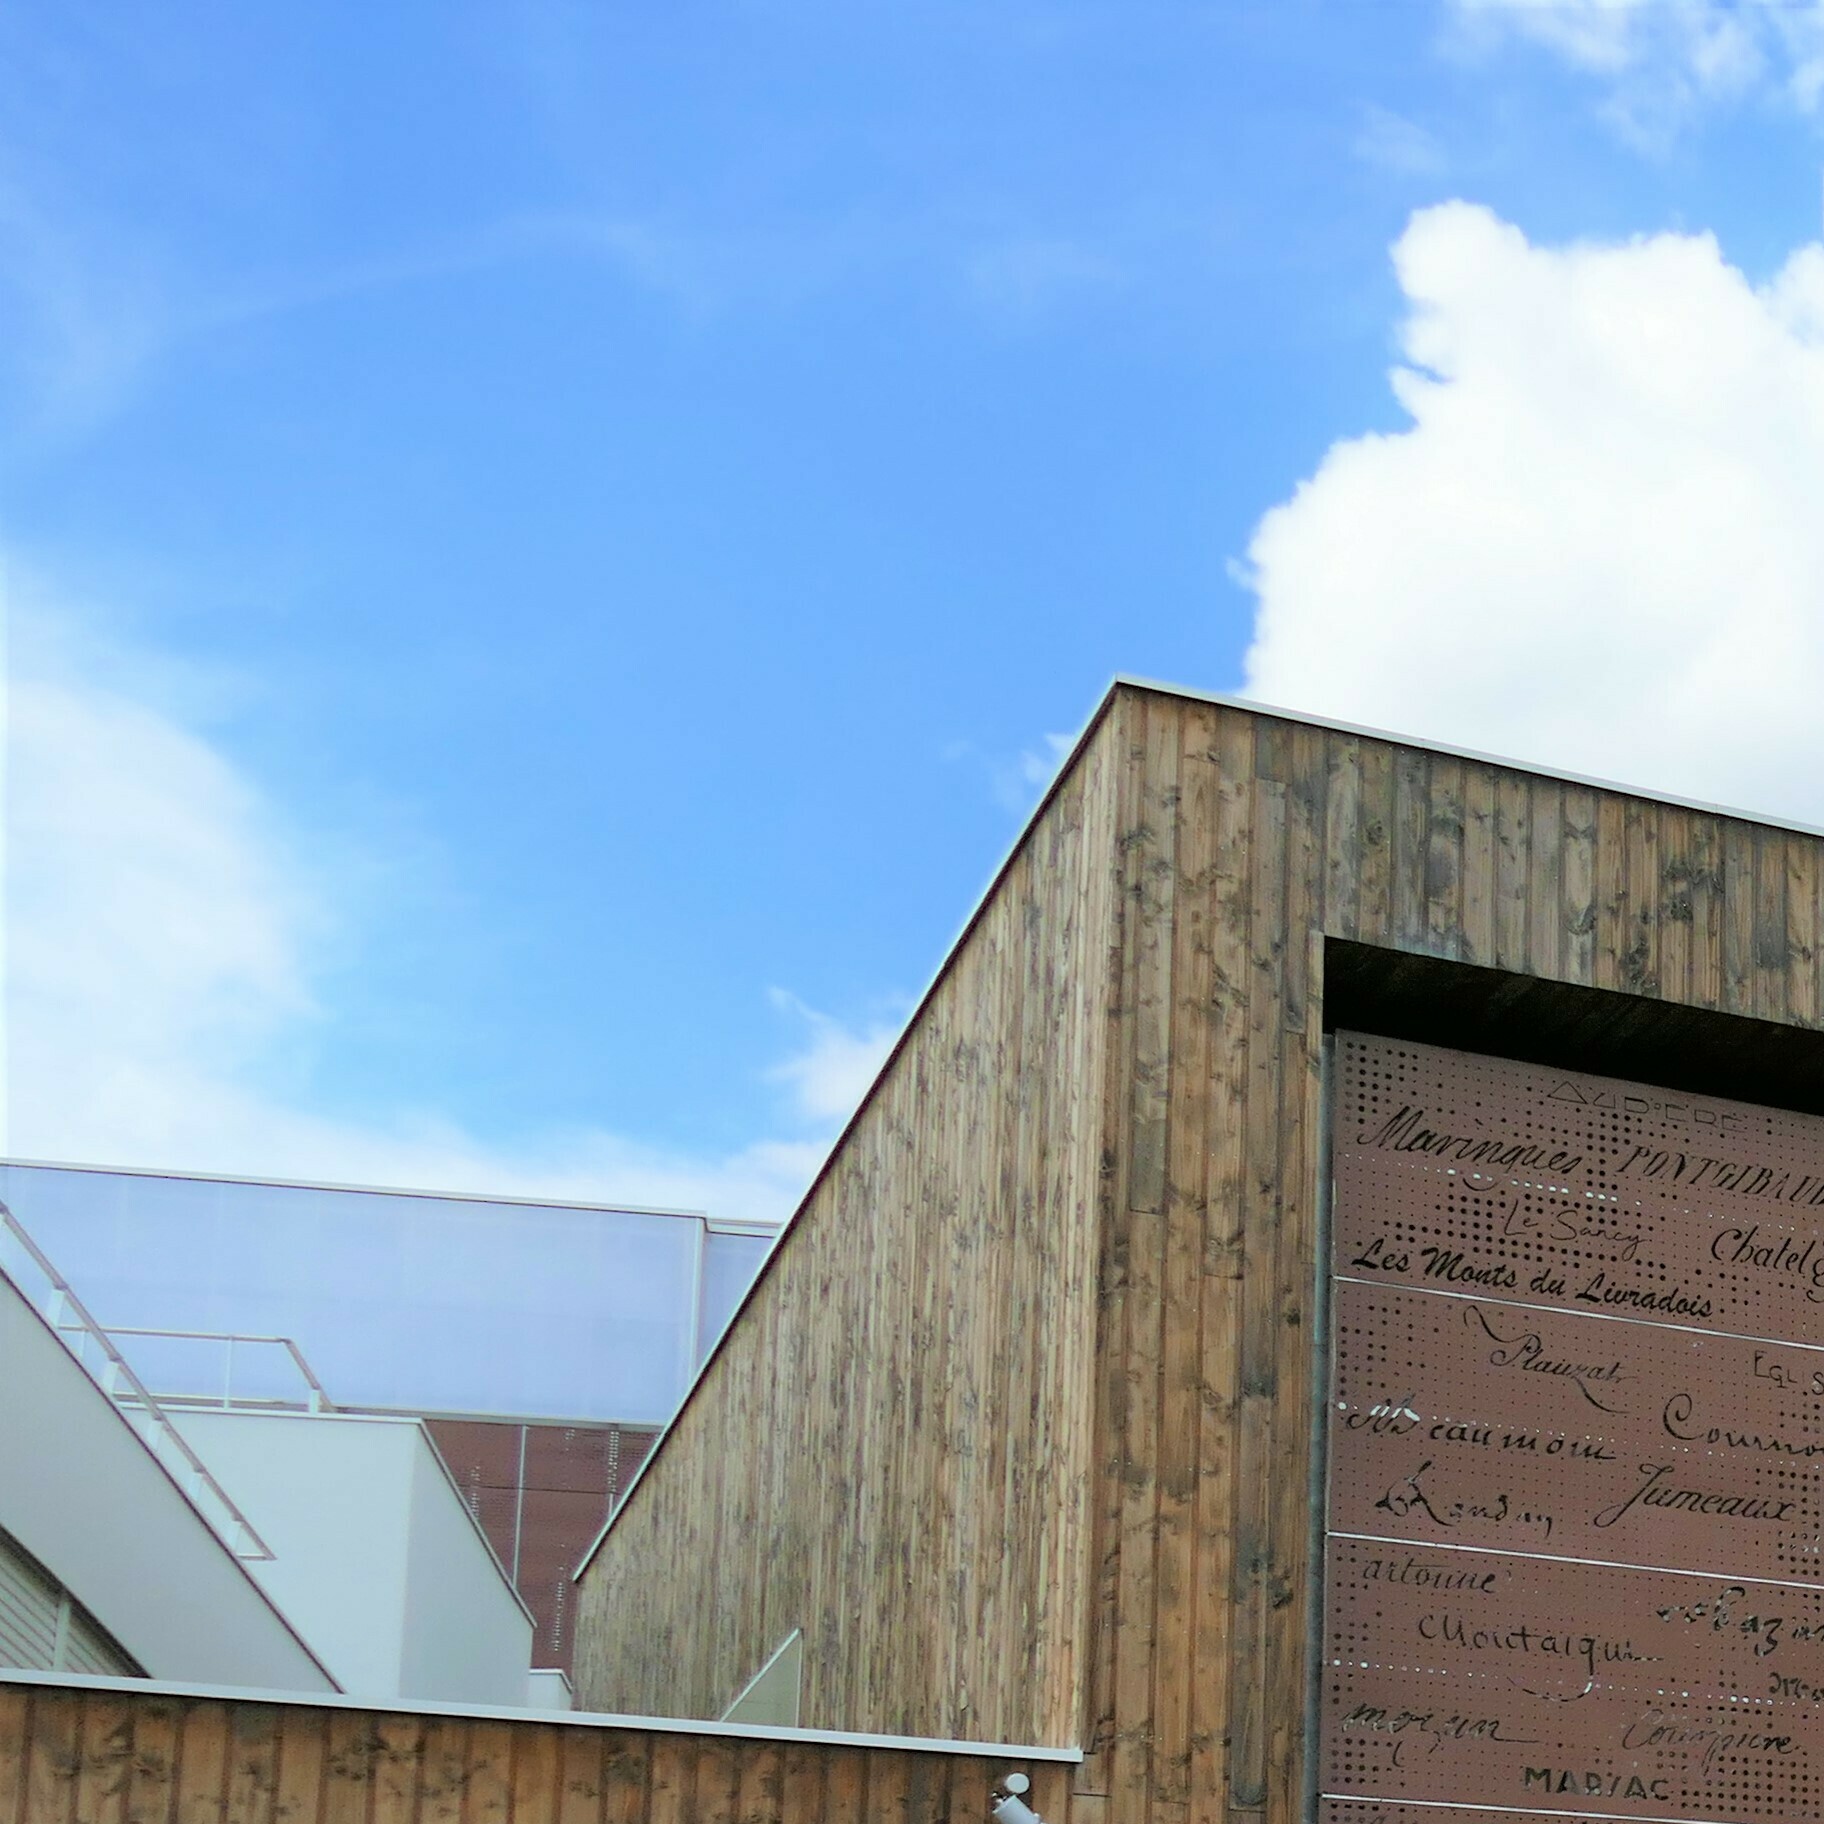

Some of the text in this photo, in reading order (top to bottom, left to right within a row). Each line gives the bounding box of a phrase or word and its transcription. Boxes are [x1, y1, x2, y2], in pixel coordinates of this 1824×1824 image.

[1503, 1199, 1649, 1262] Le Sancy
[1351, 1238, 1714, 1319] Les Monts du Livradois
[1592, 1462, 1796, 1529] Jumeaux
